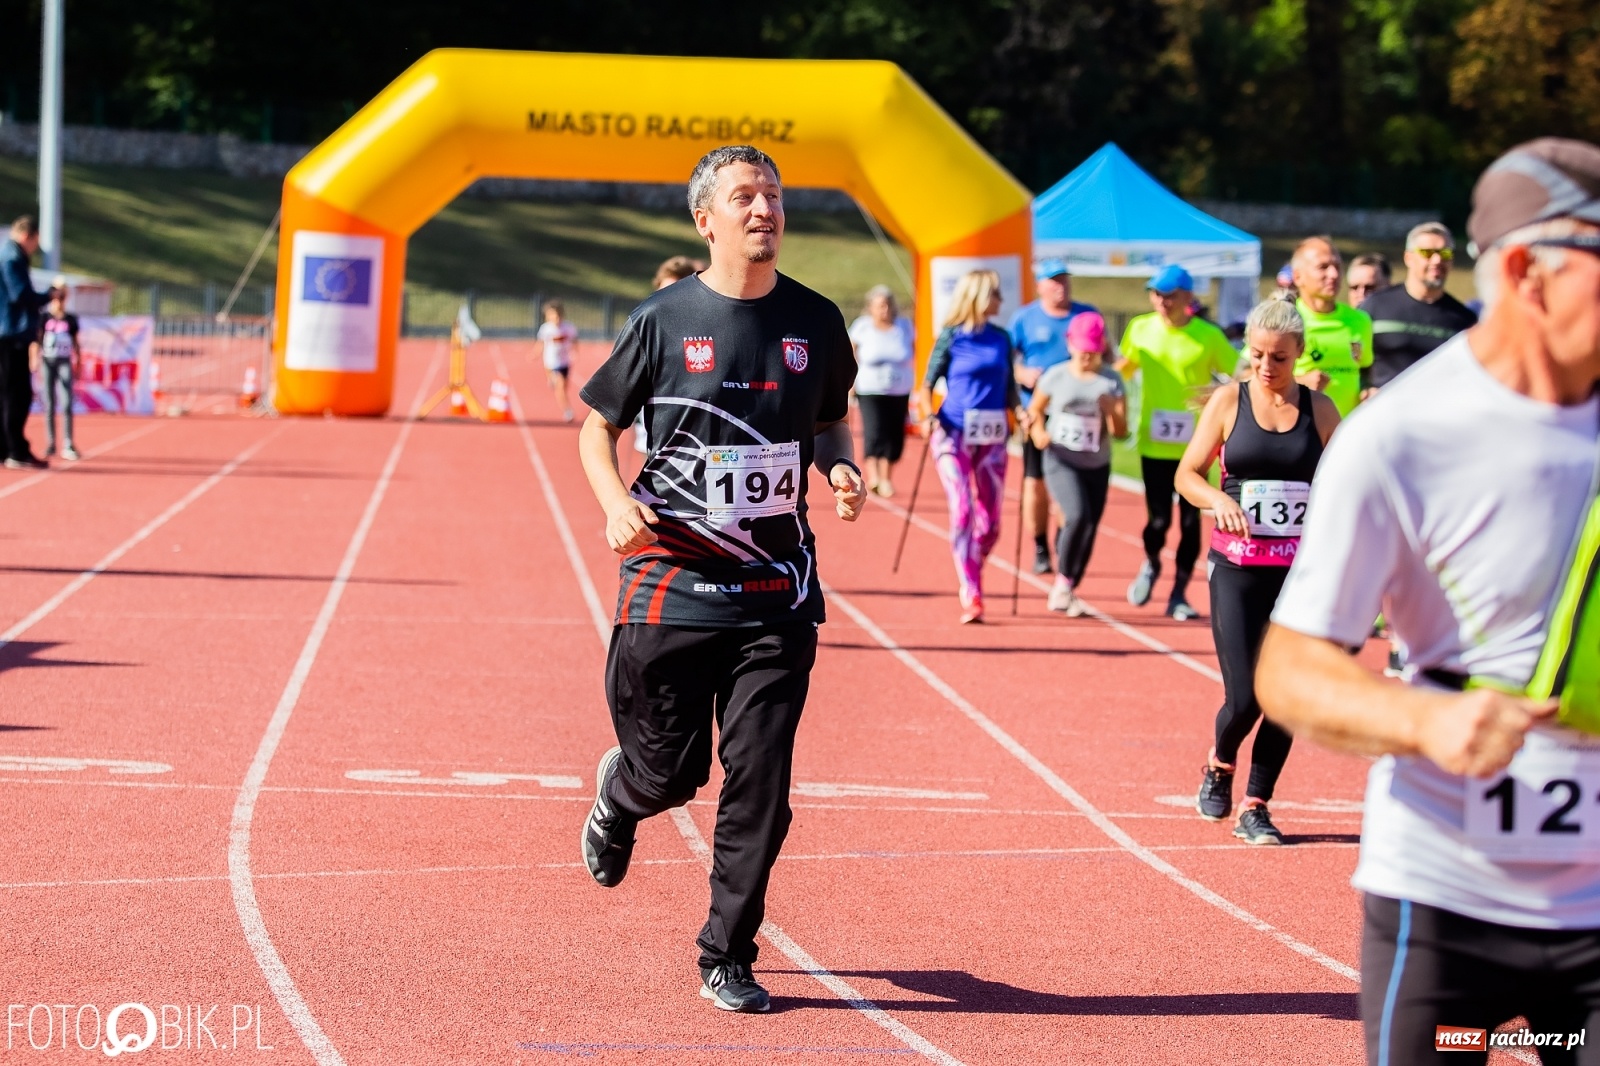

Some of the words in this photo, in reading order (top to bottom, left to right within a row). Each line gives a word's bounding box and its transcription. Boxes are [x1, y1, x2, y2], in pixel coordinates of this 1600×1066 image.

[527, 111, 637, 138] MIASTO
[646, 113, 796, 144] RACIBÓRZ
[969, 422, 1004, 438] 208
[1060, 427, 1094, 444] 221
[1159, 421, 1185, 438] 37
[743, 449, 797, 460] www.personalbest.pl
[715, 468, 795, 504] 194
[1248, 501, 1308, 526] 132
[1269, 541, 1300, 558] MA
[1484, 775, 1600, 835] 12
